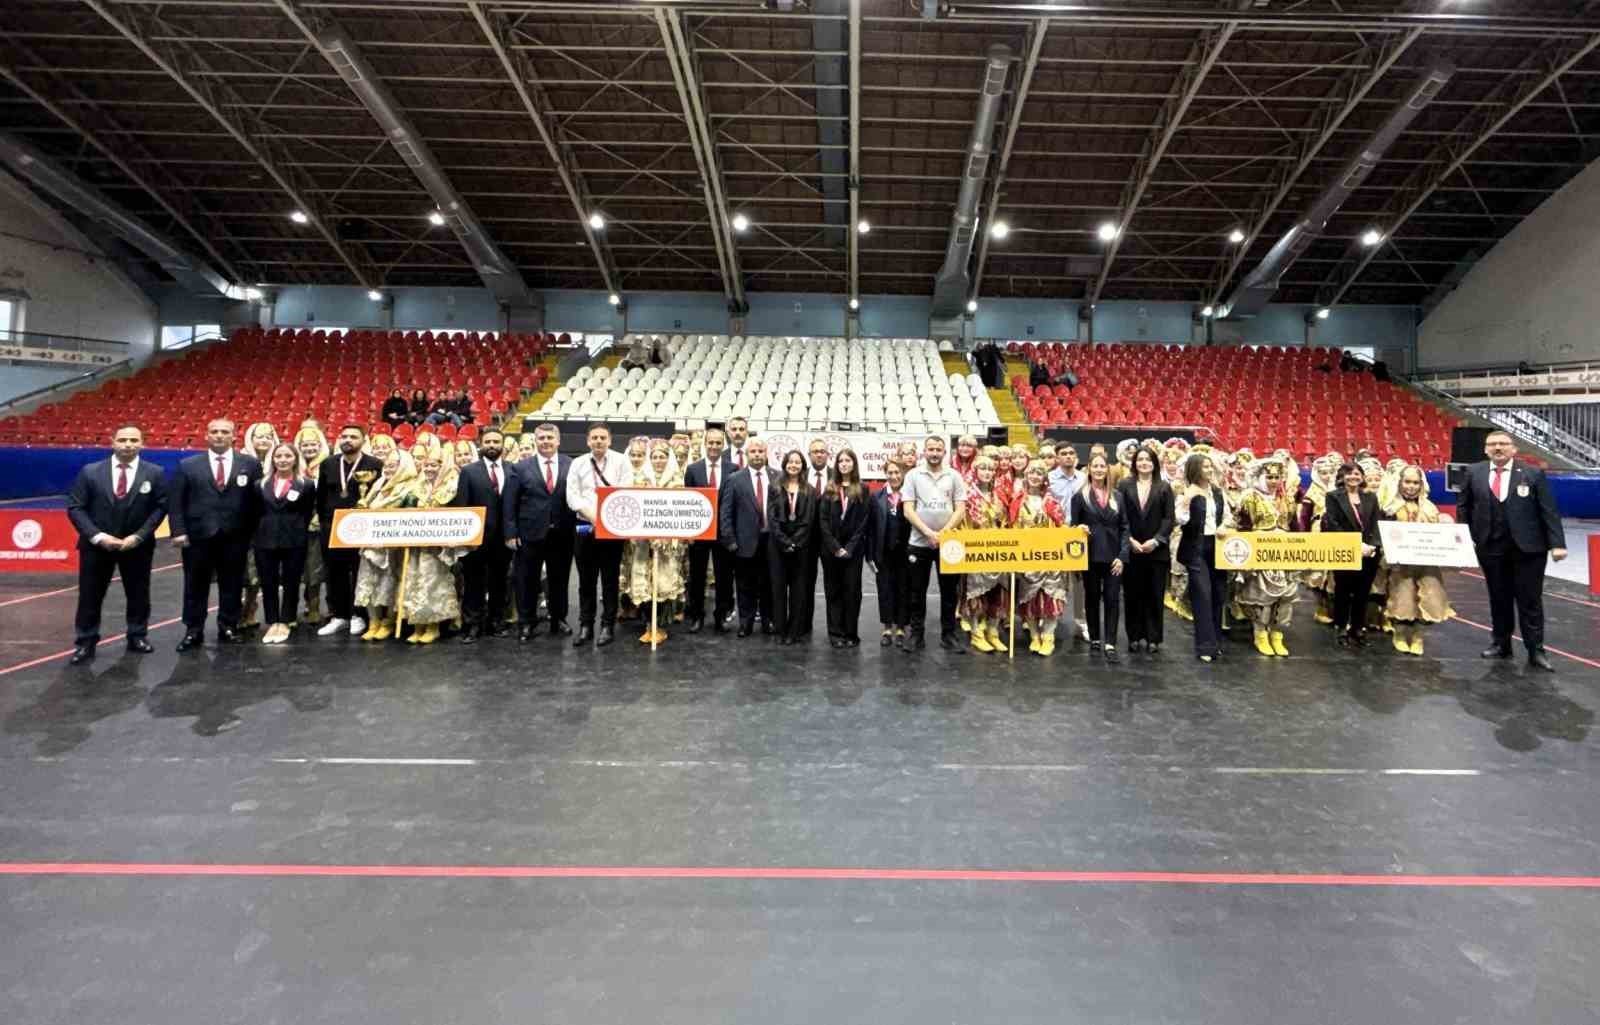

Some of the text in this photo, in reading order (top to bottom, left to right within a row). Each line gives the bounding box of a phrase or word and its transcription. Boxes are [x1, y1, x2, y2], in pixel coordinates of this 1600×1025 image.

[373, 518, 397, 528] İSMET
[399, 516, 426, 527] İNÖNÜ
[463, 518, 473, 526] VE
[643, 520, 702, 529] ANADOLU LİSESİ
[371, 528, 468, 538] TEKNİK ANADOLU LİSESİ
[965, 549, 1063, 562] MANİSA LİSESİ
[1256, 548, 1355, 563] SOMA ANADOLU LİSESİ
